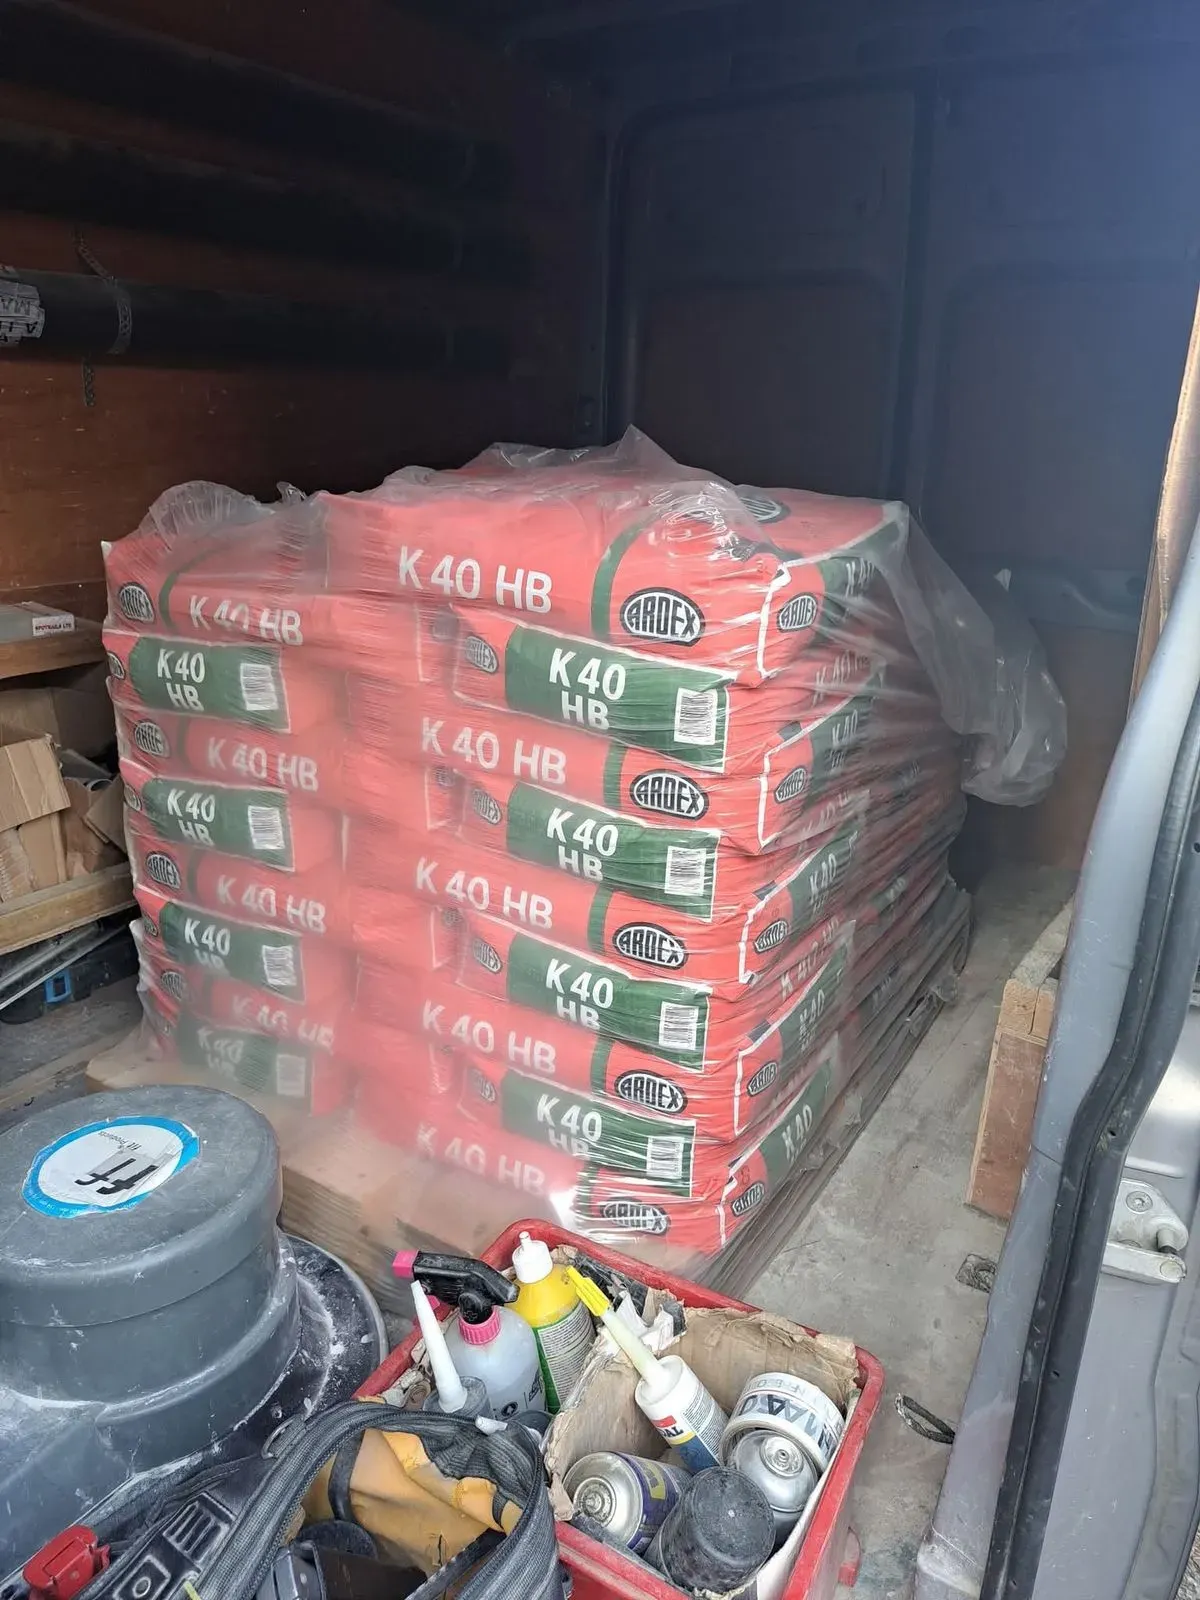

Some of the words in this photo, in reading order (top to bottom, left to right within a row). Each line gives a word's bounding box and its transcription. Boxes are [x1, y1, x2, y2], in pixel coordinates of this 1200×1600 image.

[399, 546, 423, 589] K
[431, 555, 481, 599] 40
[496, 565, 552, 613] HB
[189, 595, 209, 630] K
[260, 608, 303, 645] HB
[622, 589, 702, 643] ARDEX
[779, 595, 817, 630] ARDEX
[157, 649, 175, 680] K
[175, 652, 205, 683] 40
[549, 648, 576, 688] K
[578, 654, 627, 700] 40
[166, 683, 204, 711] HB
[561, 691, 610, 731] HB
[208, 737, 227, 770] K
[232, 747, 267, 779] 40
[277, 752, 319, 792] HB
[421, 717, 444, 755] K
[453, 727, 500, 769] 40
[513, 739, 566, 785] HB
[167, 788, 183, 817] K
[185, 793, 215, 823] 40
[631, 771, 706, 818] ARDEX
[178, 819, 215, 847] HB
[546, 807, 573, 843] K
[573, 816, 619, 856] 40
[146, 853, 181, 889] ARDEX
[557, 845, 603, 882] HB
[217, 875, 237, 906] K
[242, 887, 277, 917] 40
[286, 896, 327, 934] HB
[416, 857, 438, 895] K
[445, 871, 490, 911] 40
[503, 886, 553, 929] HB
[184, 917, 201, 947] K
[202, 925, 231, 956] 40
[615, 925, 687, 968] ARDEX
[545, 958, 572, 995] K
[570, 966, 614, 1009] 40
[556, 995, 601, 1030] HB
[422, 1000, 445, 1036] K
[451, 1014, 494, 1054] 40
[508, 1031, 556, 1075] HB
[616, 1070, 686, 1112] ARDEX
[536, 1093, 559, 1127] K
[561, 1103, 602, 1142] 40
[415, 1122, 437, 1158] K
[445, 1137, 486, 1175] 40
[498, 1155, 546, 1195] HB
[548, 1128, 592, 1161] HB
[602, 1200, 669, 1236] ARDEX
